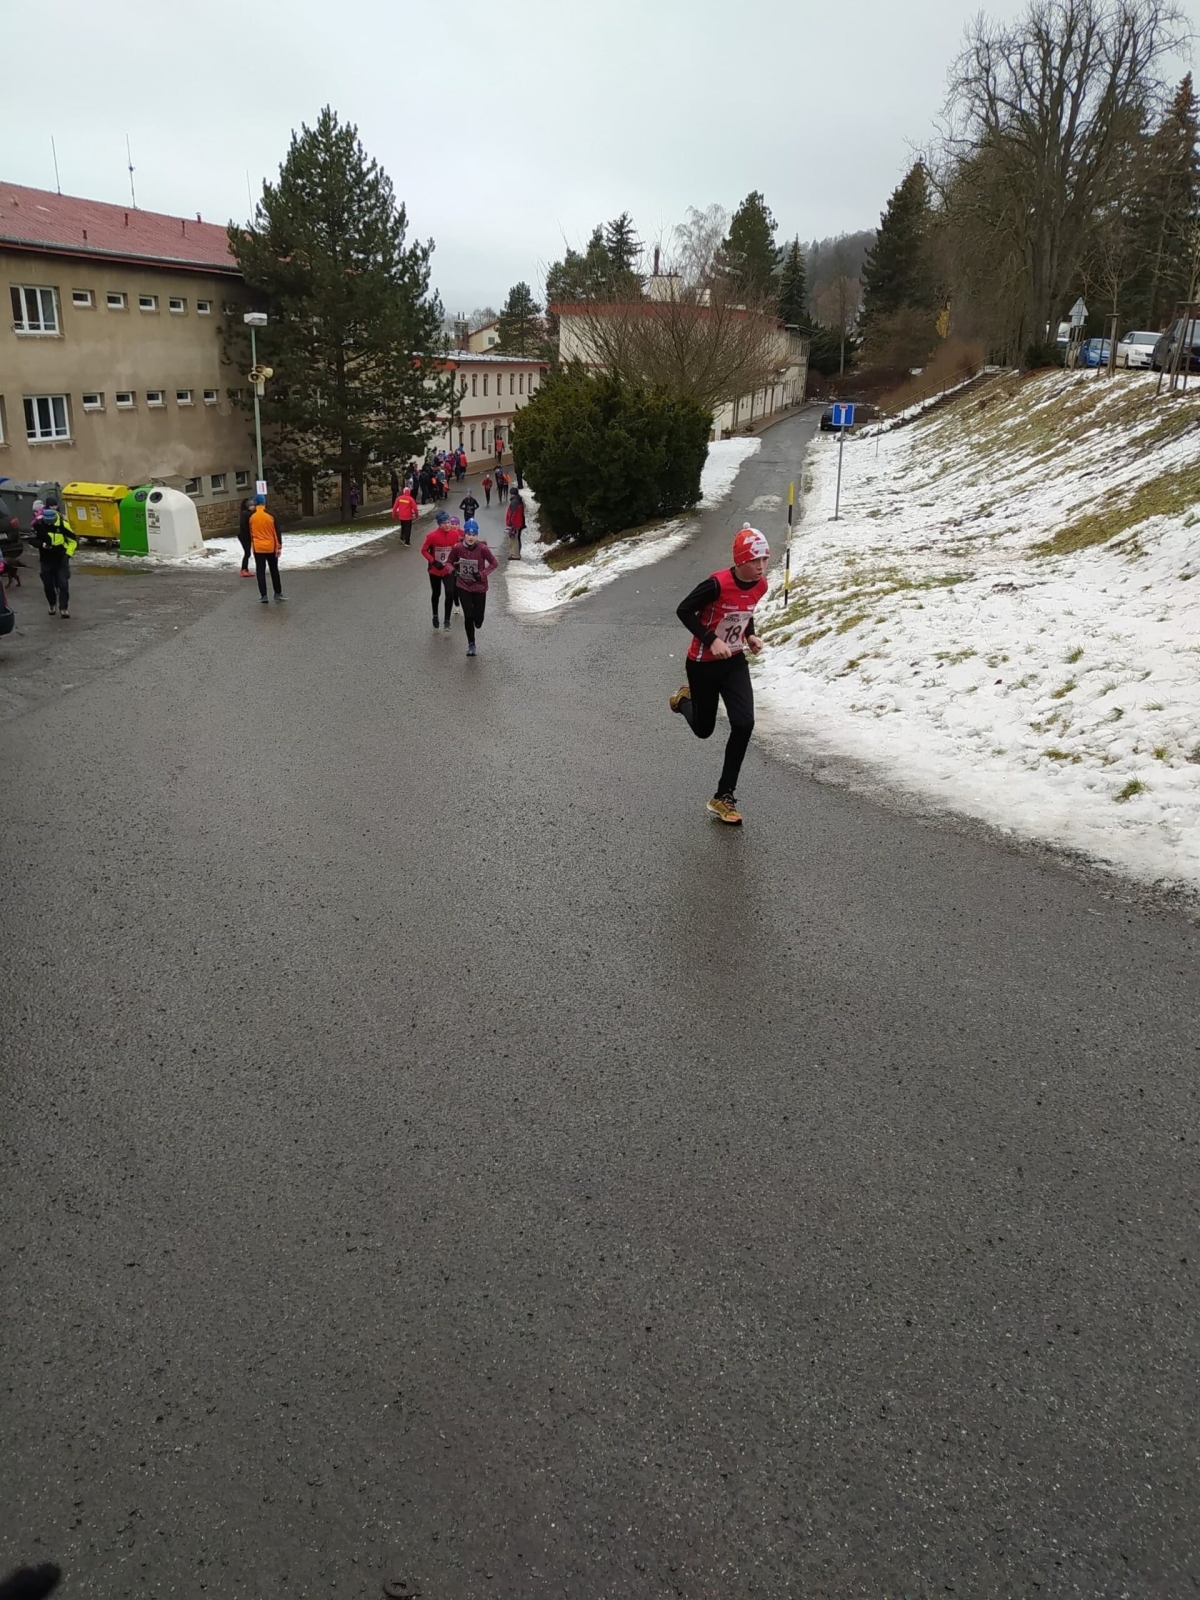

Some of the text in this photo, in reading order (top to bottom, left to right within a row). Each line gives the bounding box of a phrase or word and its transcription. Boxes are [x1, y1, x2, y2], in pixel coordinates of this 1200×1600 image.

[440, 552, 446, 561] 8
[462, 565, 475, 575] 33
[724, 625, 742, 644] 18
